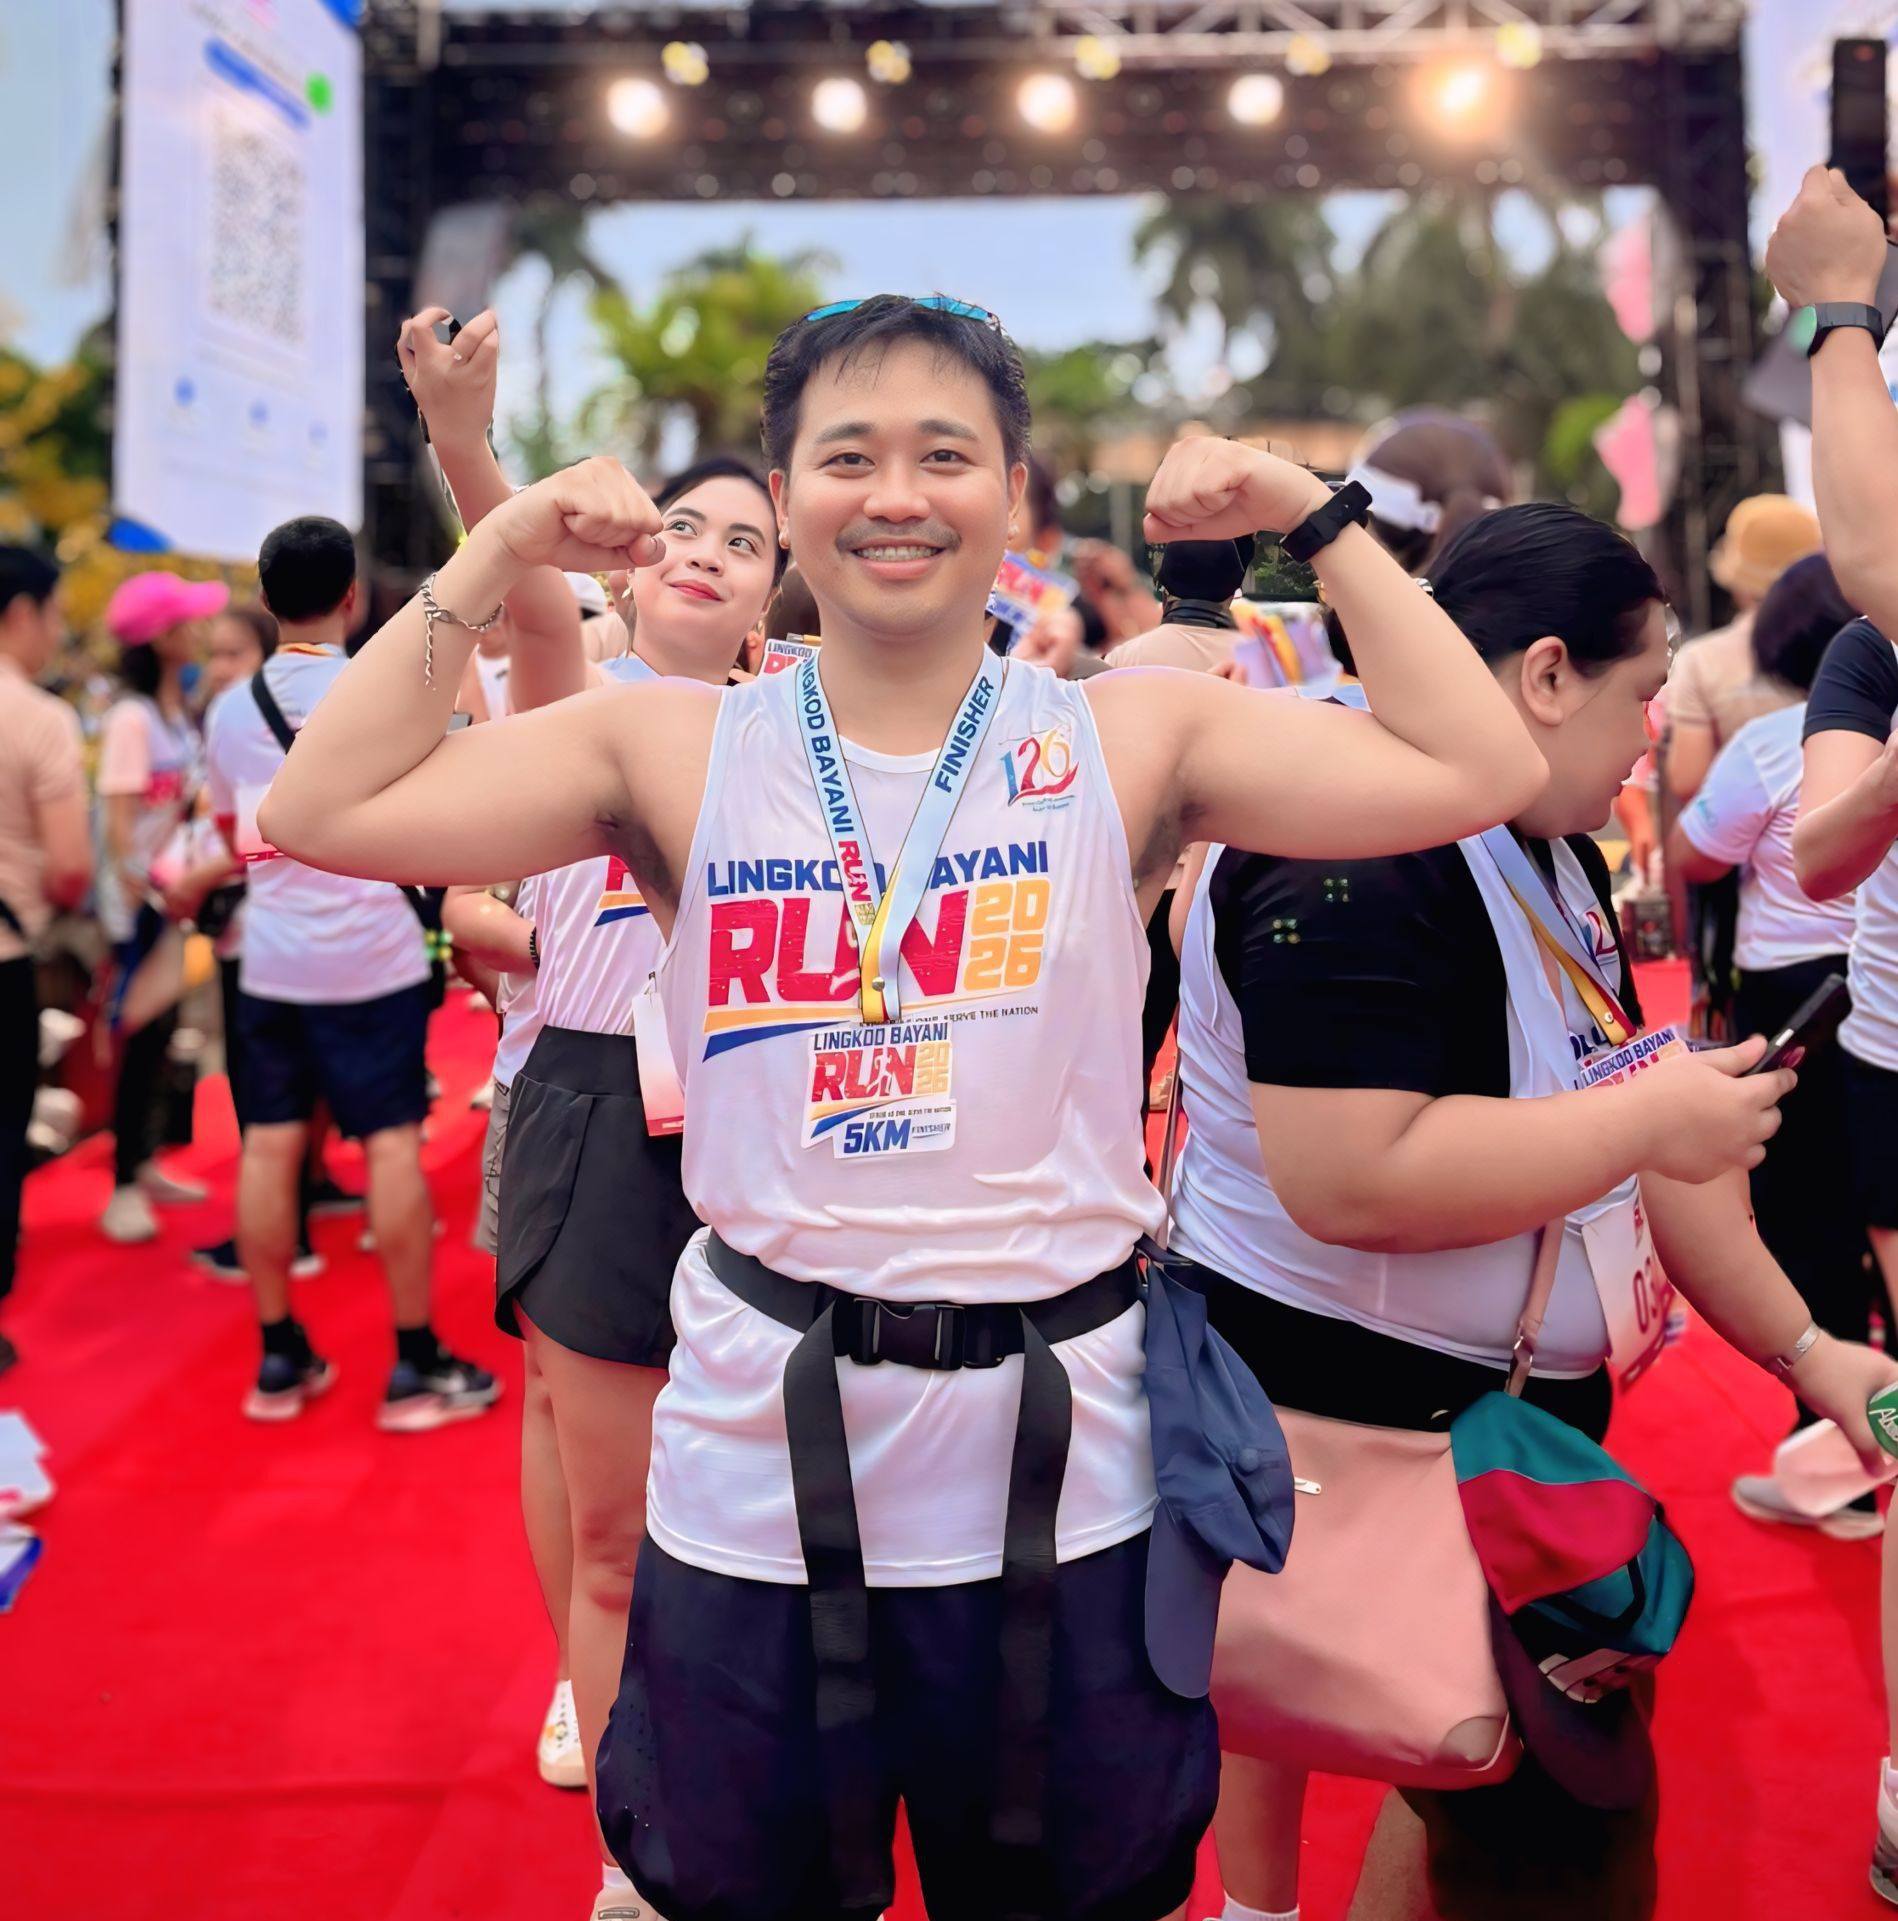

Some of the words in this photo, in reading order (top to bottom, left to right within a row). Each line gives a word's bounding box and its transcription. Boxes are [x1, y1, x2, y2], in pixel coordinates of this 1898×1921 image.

[934, 676, 995, 793] FINISHER
[811, 735, 855, 833] BAYANI
[838, 840, 872, 902] RUN
[930, 841, 1050, 890] AYANI
[890, 1022, 949, 1044] BAYANI
[1001, 1006, 1038, 1017] NATION
[811, 1044, 917, 1103] RUN
[843, 1118, 911, 1154] 5KM
